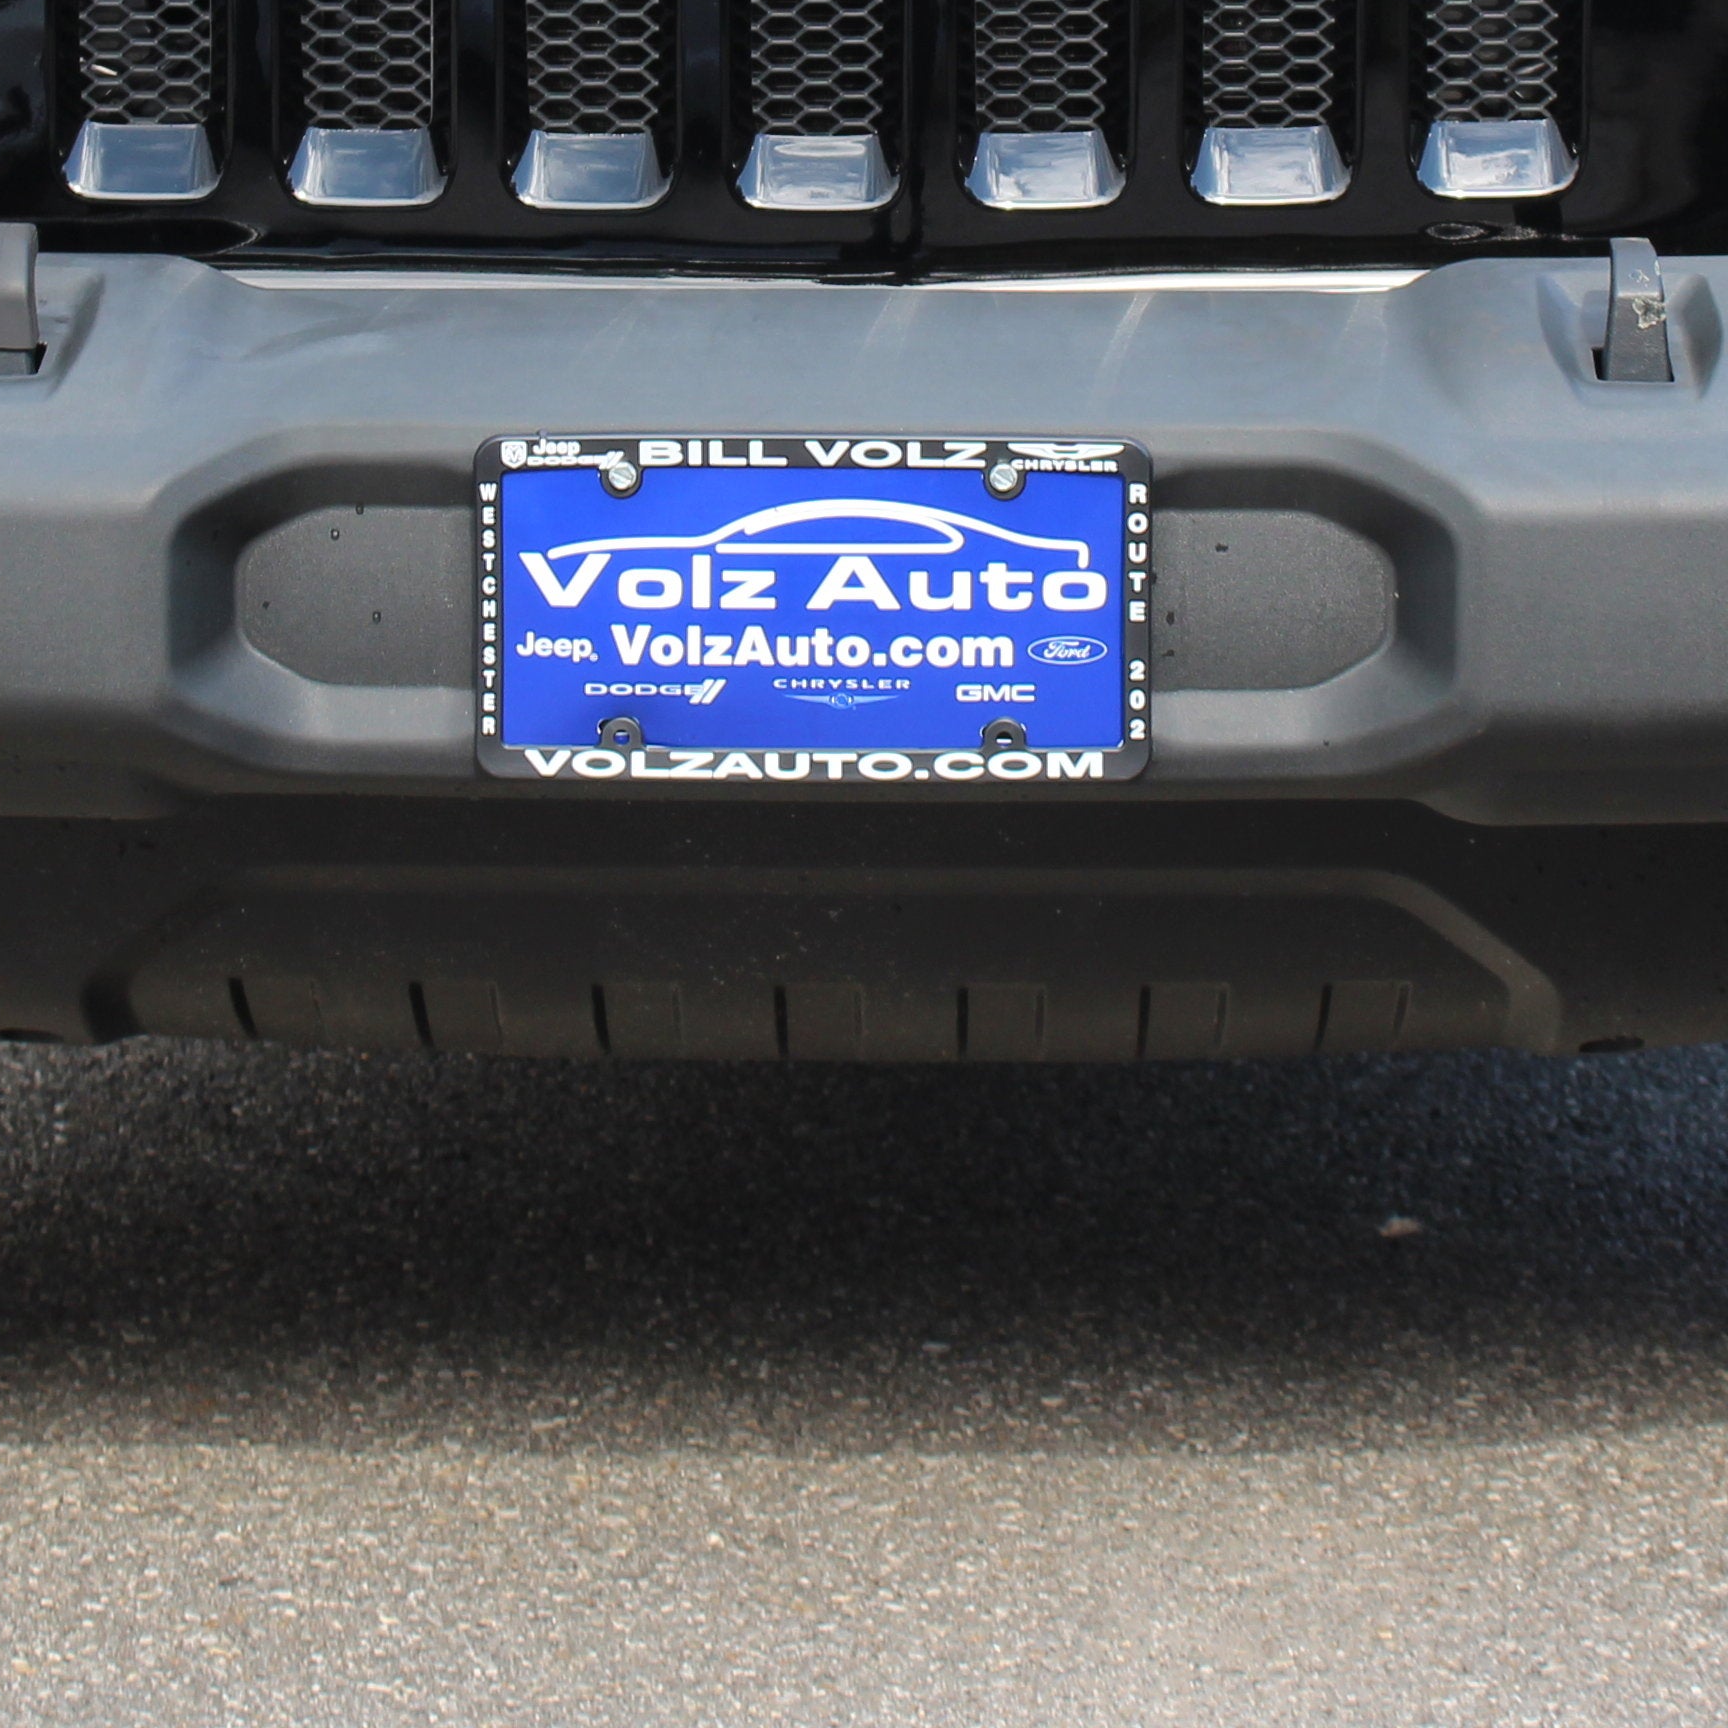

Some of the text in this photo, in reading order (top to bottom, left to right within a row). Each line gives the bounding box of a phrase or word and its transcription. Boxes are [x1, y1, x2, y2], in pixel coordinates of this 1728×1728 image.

[532, 438, 582, 456] Jeep
[638, 440, 987, 468] BILL VOLZ
[1010, 459, 1120, 473] CHRYSLER
[518, 552, 1108, 612] Volz Auto
[479, 483, 498, 736] WESTCHESTER
[1127, 483, 1149, 741] ROUTE 202
[610, 624, 1015, 667] VolzAuto.com
[583, 678, 1037, 702] DODGE CHRYSLER GMC
[524, 749, 1104, 780] VOLZAUTO.COM
